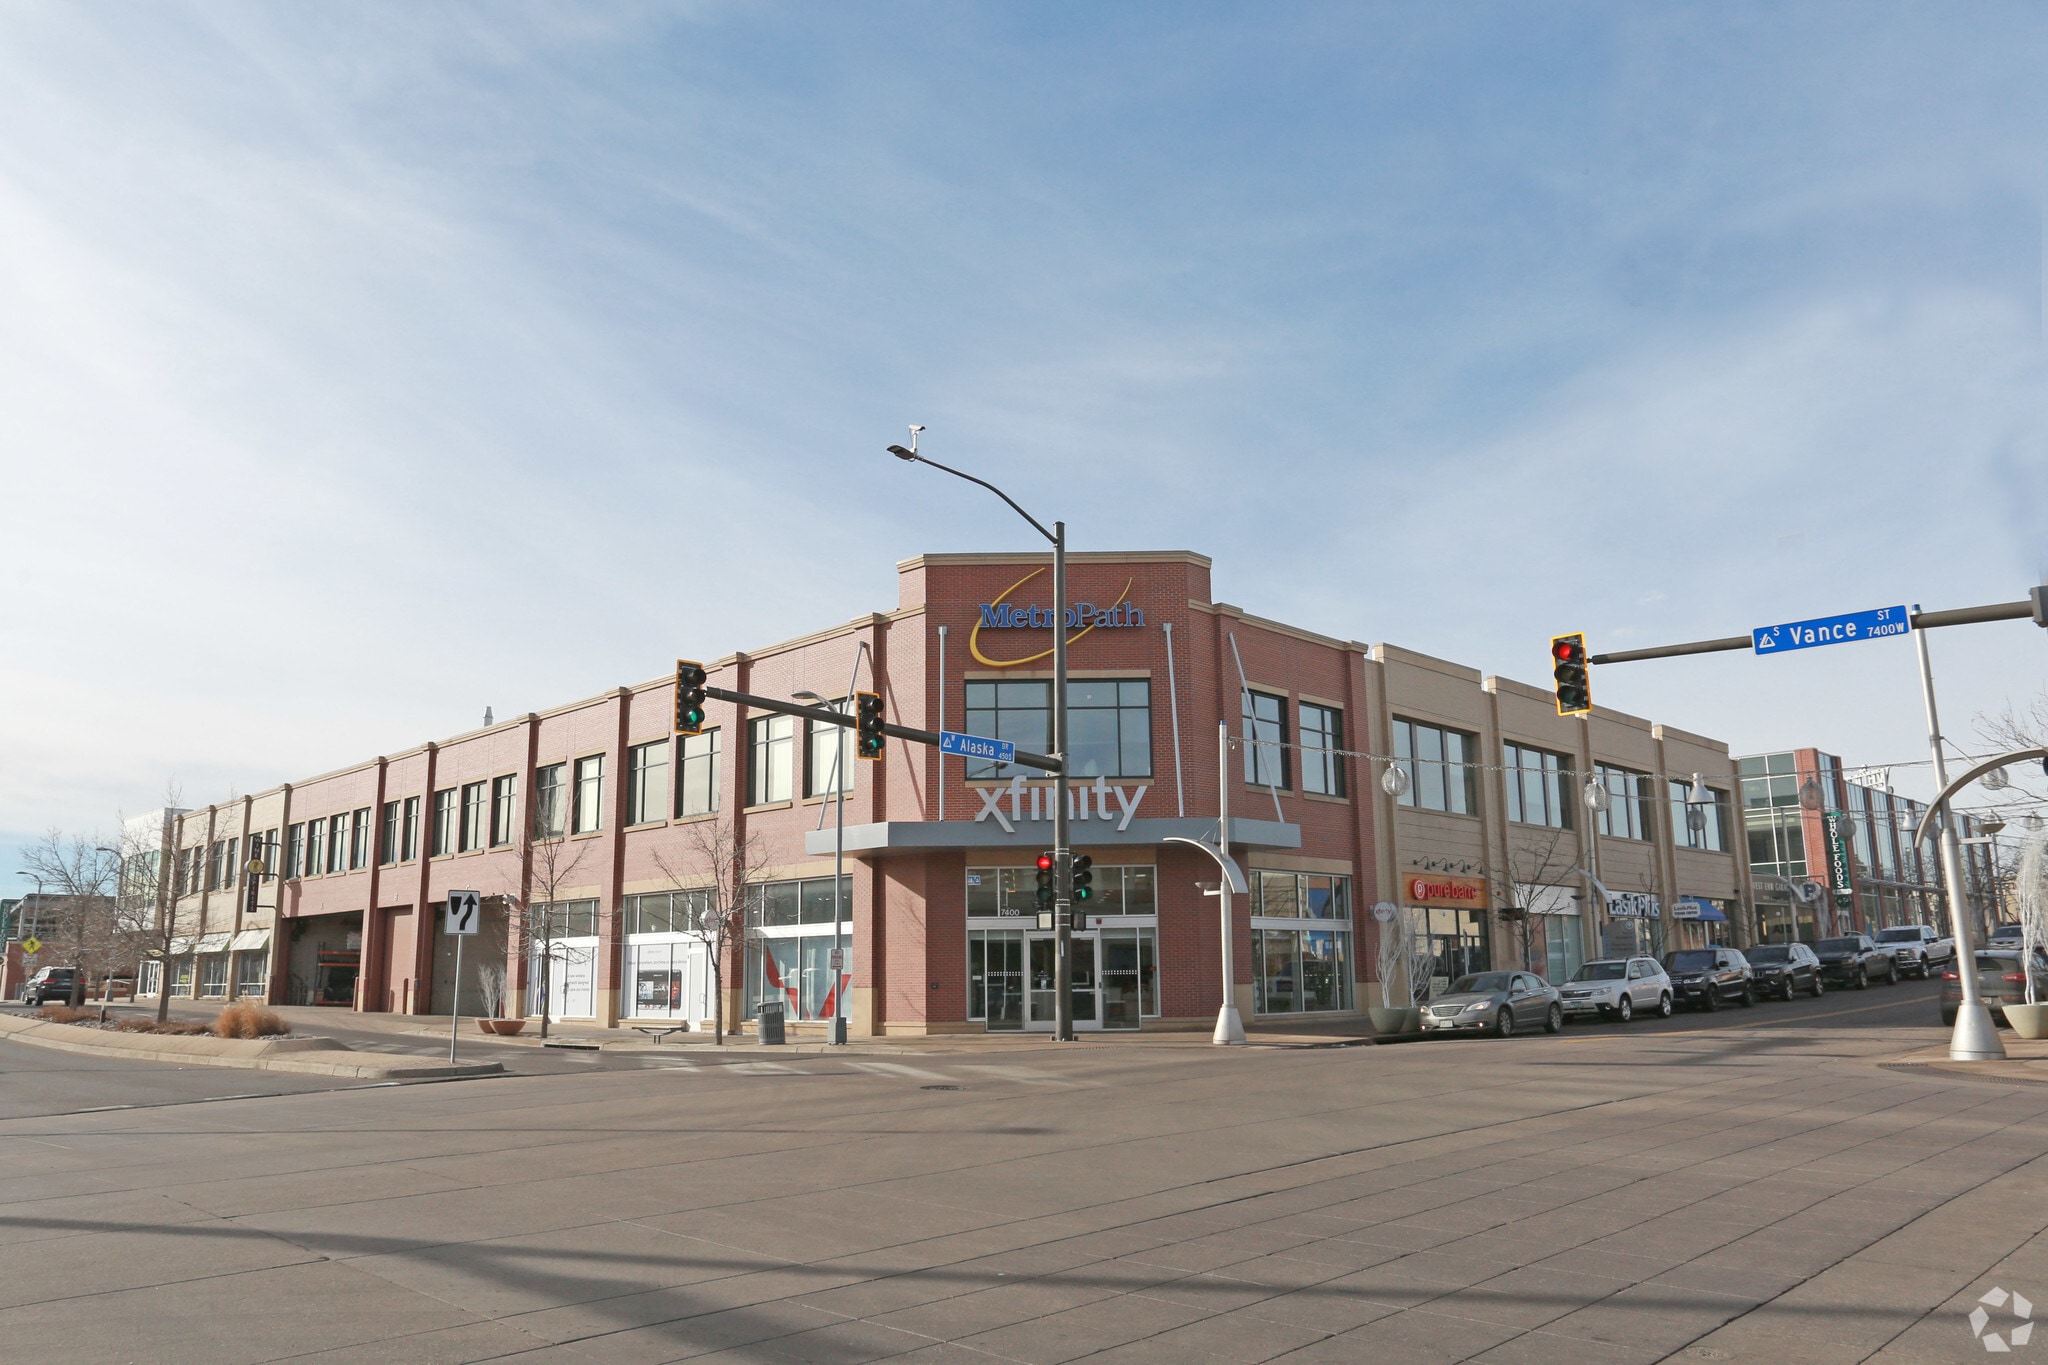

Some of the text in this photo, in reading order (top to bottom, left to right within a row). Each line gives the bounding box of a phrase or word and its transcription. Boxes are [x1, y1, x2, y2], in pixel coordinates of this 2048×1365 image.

[979, 601, 1146, 628] MetroPath
[1877, 609, 1890, 621] ST
[1773, 626, 1780, 636] S
[1789, 622, 1857, 645] Vance
[960, 738, 995, 756] Alaska
[1001, 742, 1009, 750] DR
[974, 774, 1148, 833] xfinity
[1827, 815, 1840, 852] WHOLE
[1833, 853, 1844, 889] FOODS
[1427, 884, 1450, 899] pure
[1451, 882, 1478, 899] barre
[1609, 894, 1660, 917] LasikPlus
